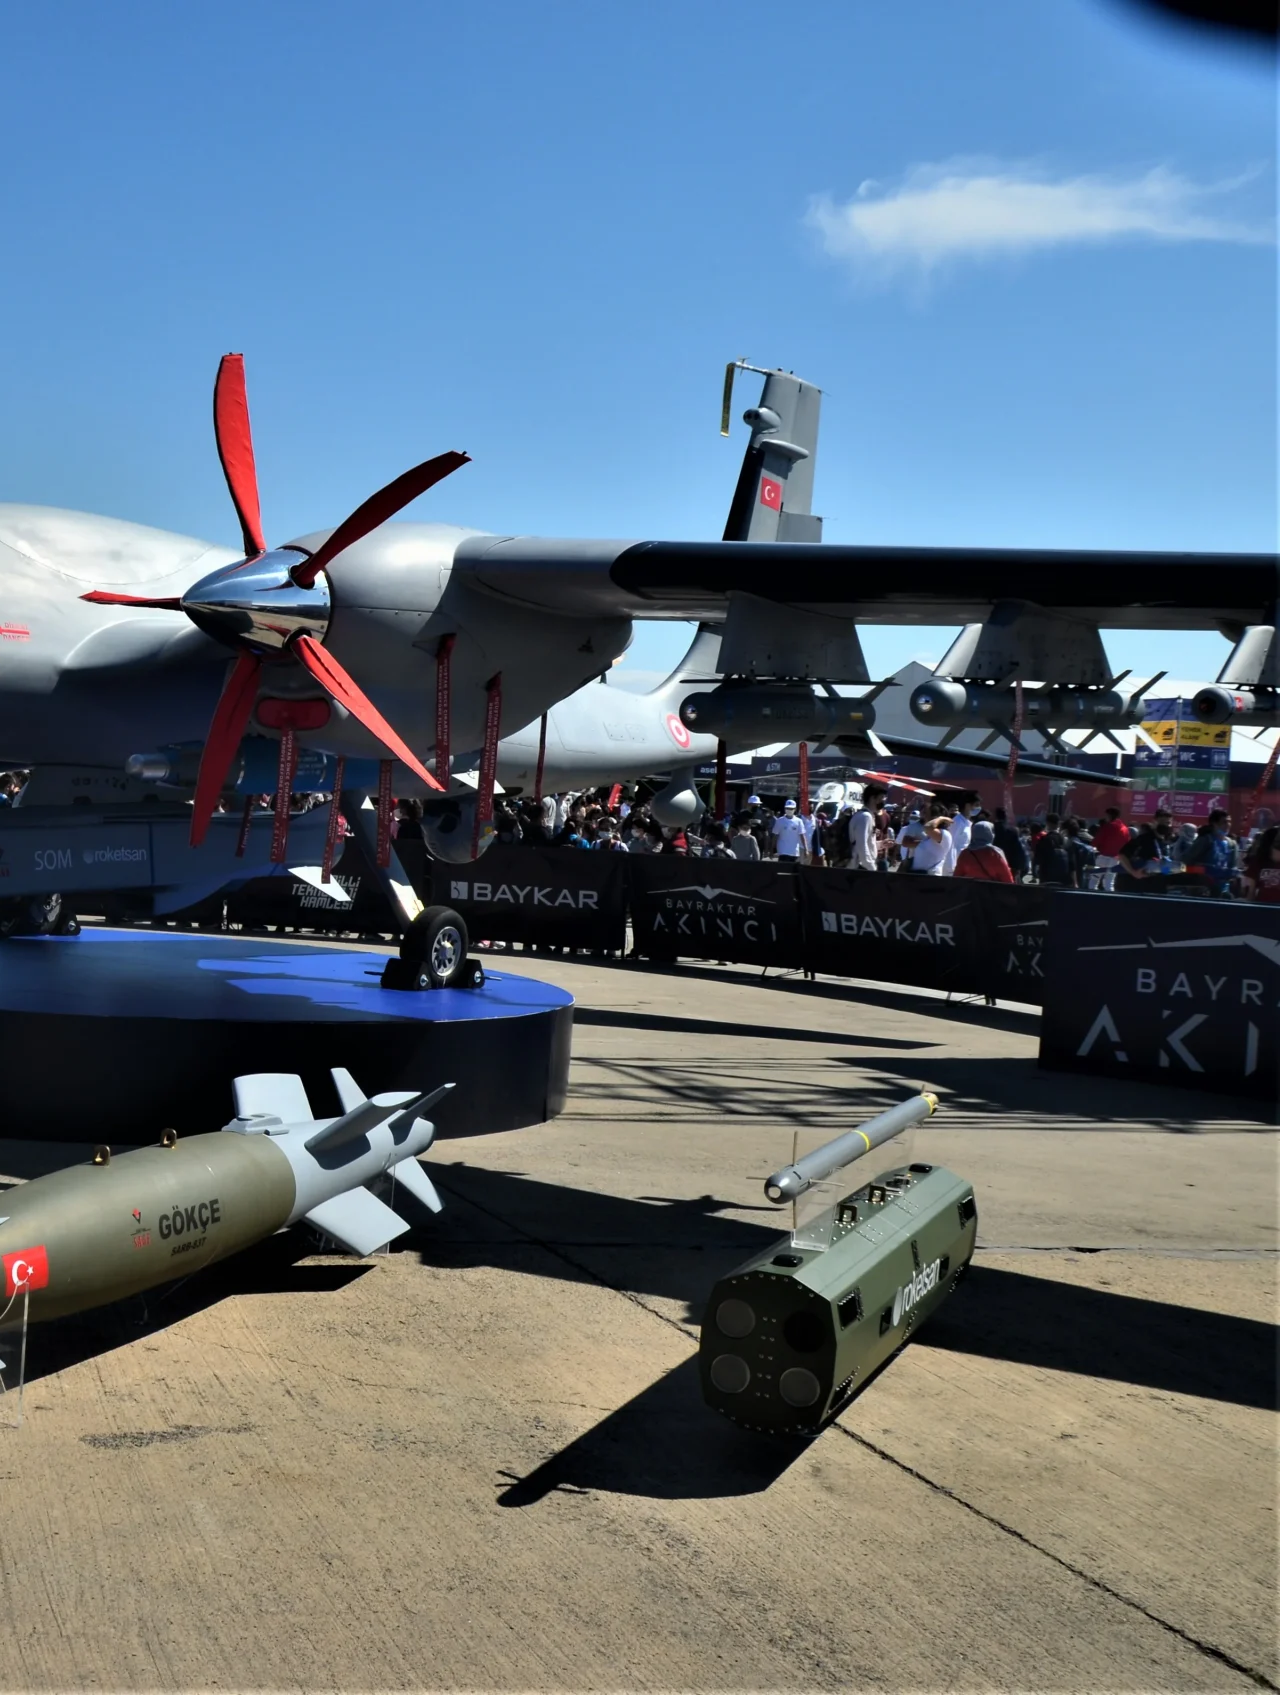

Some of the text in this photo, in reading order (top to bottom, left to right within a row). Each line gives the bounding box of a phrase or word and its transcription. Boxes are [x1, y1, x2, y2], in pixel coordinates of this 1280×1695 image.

[1180, 751, 1196, 762] WC
[700, 766, 732, 775] aseln
[34, 848, 73, 871] SOM
[94, 846, 147, 863] roketsan
[473, 883, 599, 910] BAYKAR
[666, 898, 757, 916] BAYRAKTAR
[653, 912, 777, 942] AKINCI
[840, 913, 955, 946] BAYKAR
[158, 1198, 221, 1240] GÖKÇE
[901, 1258, 940, 1316] roketsan
